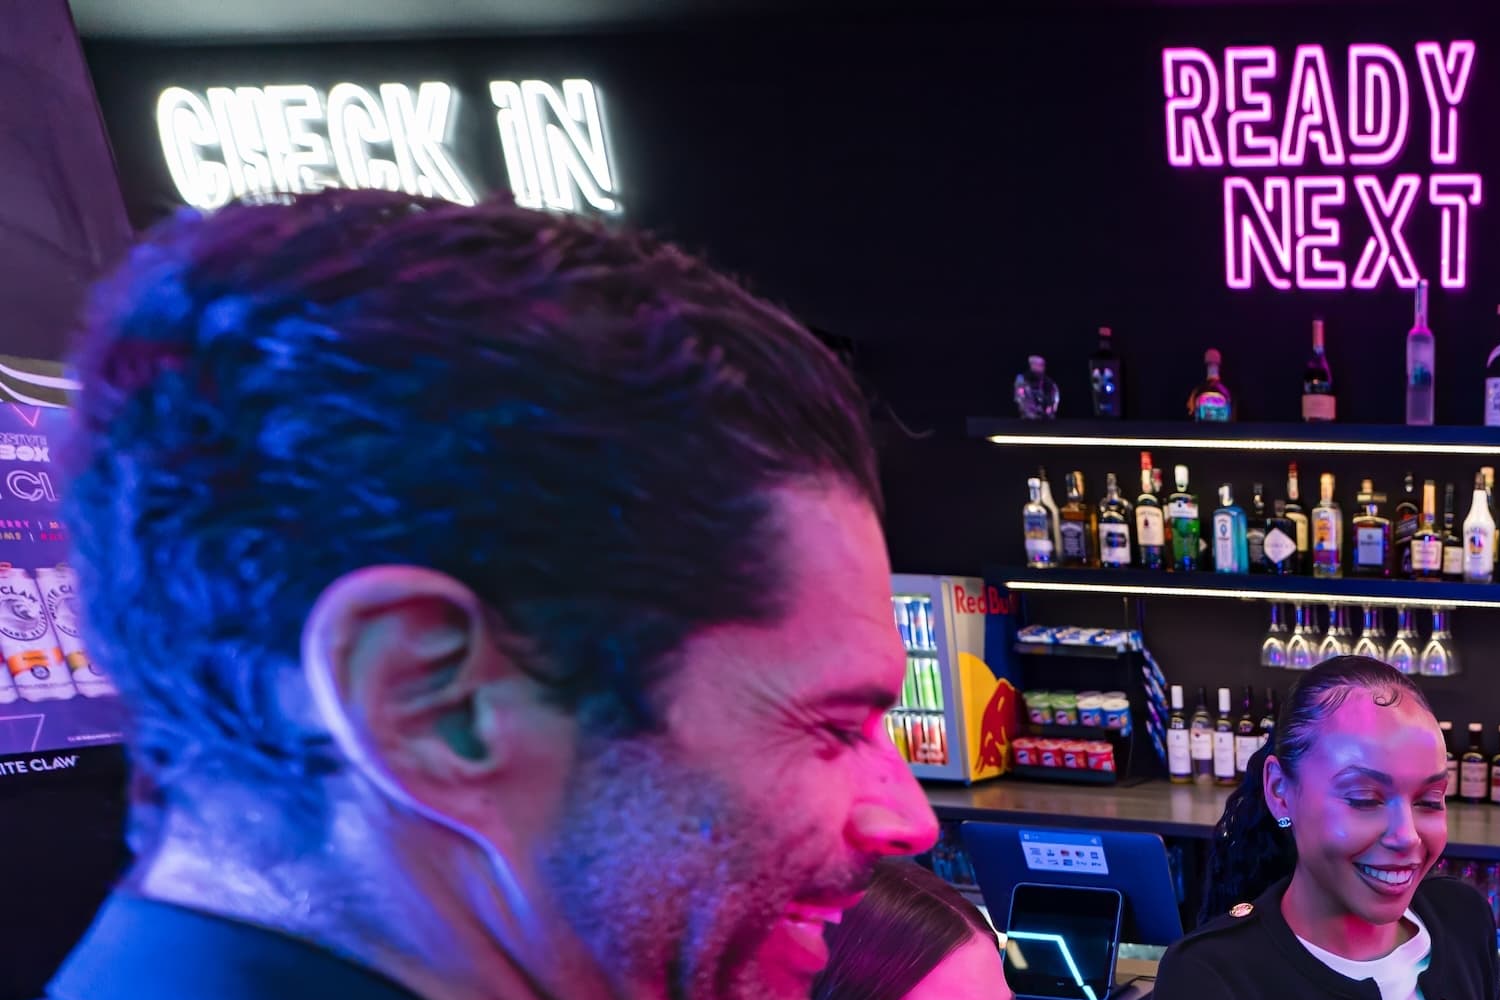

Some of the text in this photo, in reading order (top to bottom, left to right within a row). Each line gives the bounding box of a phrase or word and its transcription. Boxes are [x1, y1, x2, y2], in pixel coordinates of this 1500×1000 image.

[157, 81, 479, 210] CHECK
[1162, 40, 1476, 167] READY
[1223, 173, 1482, 291] NEXT
[954, 583, 987, 615] Red
